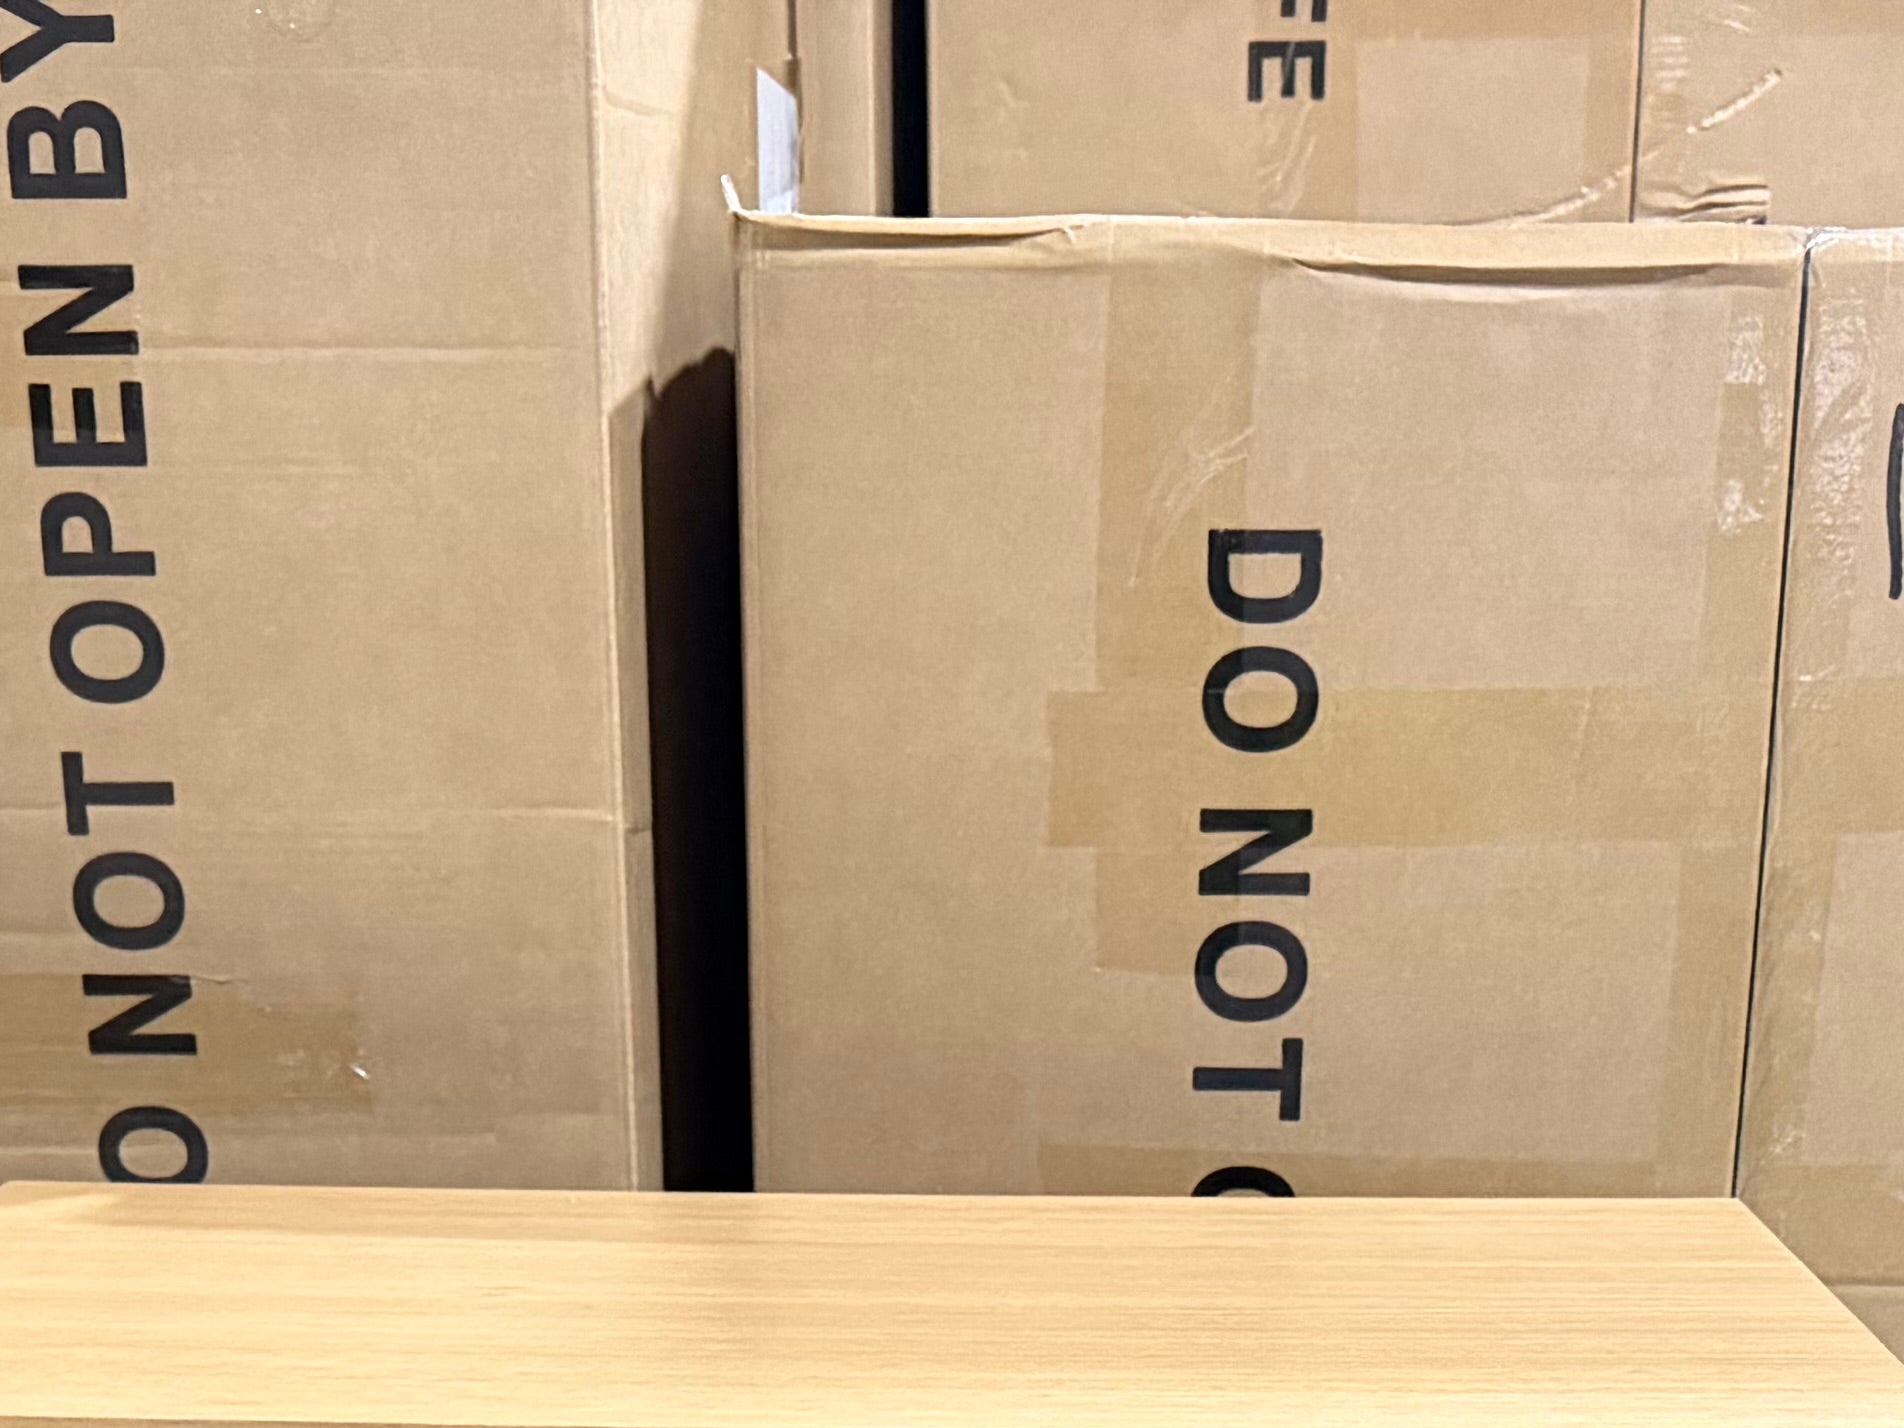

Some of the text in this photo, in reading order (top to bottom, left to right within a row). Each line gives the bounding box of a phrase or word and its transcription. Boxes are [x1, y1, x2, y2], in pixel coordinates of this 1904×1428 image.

[17, 264, 165, 704] OPEN
[1201, 528, 1323, 753] DO
[61, 751, 198, 1056] NOT
[1192, 808, 1313, 1122] NOT
